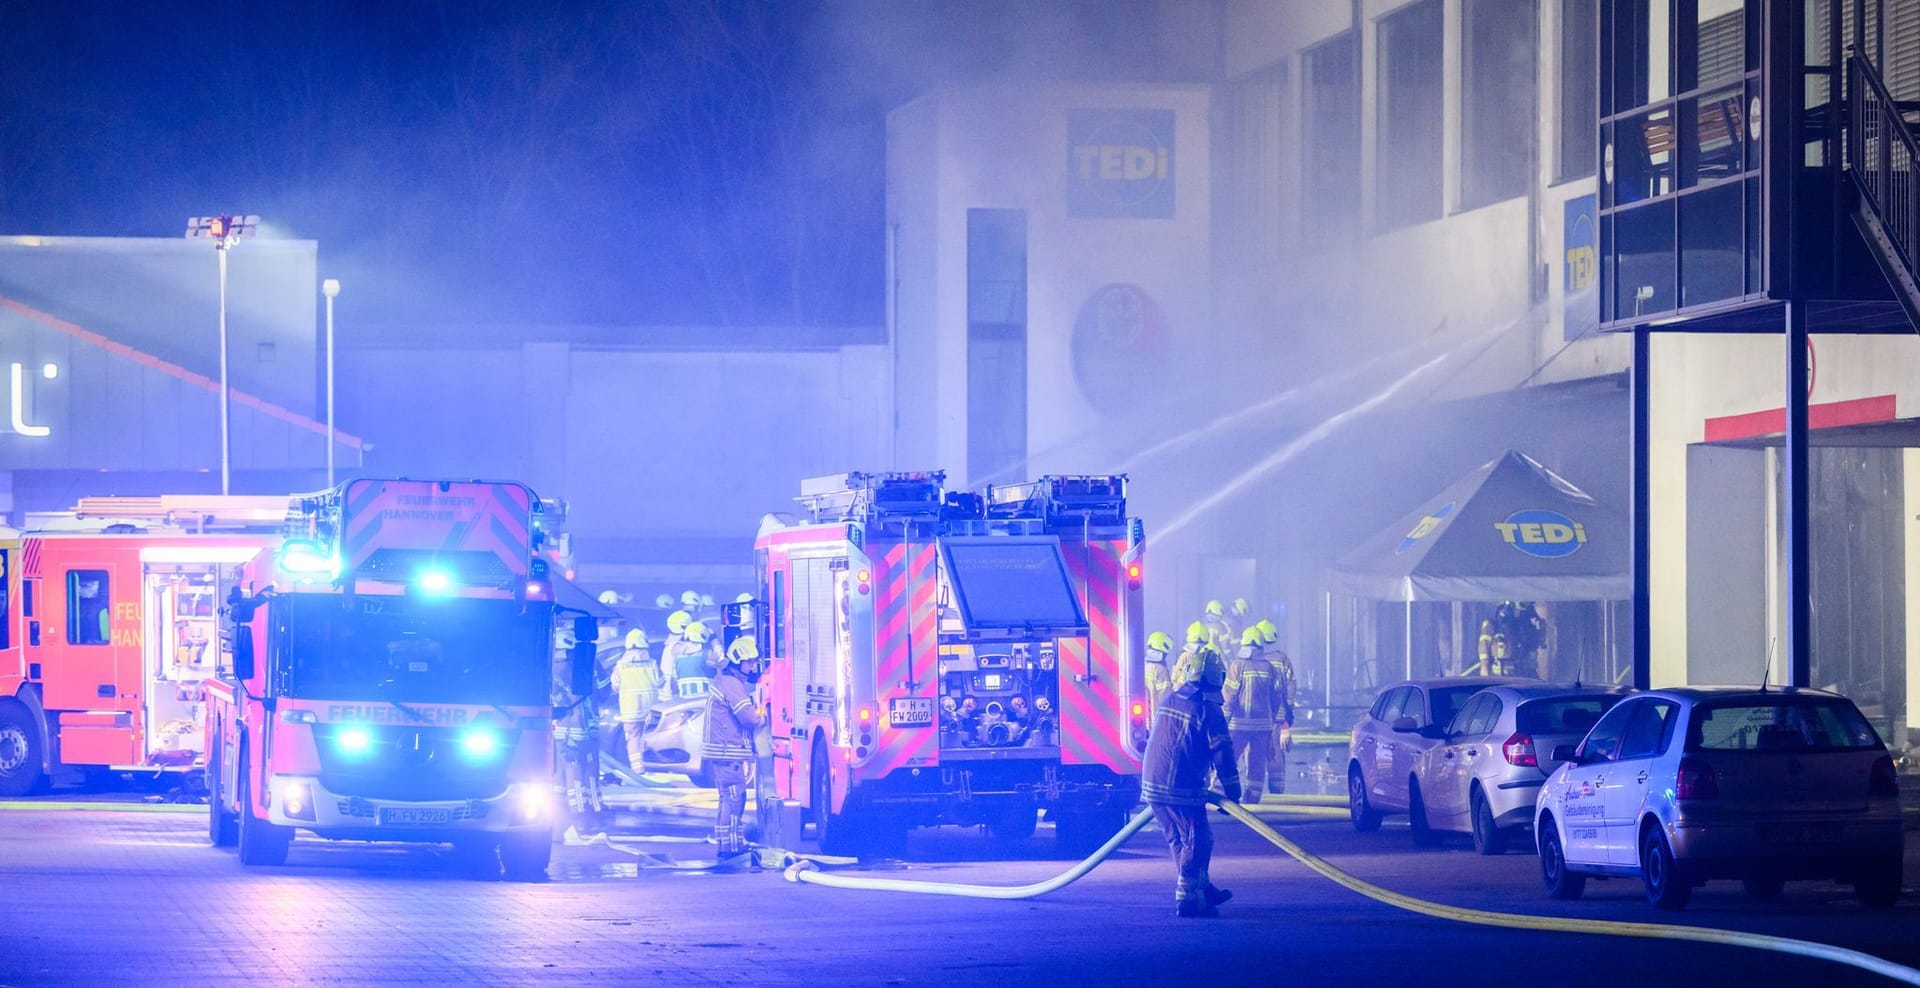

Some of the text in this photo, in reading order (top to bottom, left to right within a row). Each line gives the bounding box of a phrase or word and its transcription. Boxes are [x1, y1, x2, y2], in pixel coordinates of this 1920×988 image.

[1073, 144, 1168, 180] TEDi
[397, 495, 475, 506] FEUERWEHR
[383, 509, 454, 521] HANNOVER
[1493, 522, 1588, 544] TEDi
[910, 701, 916, 710] H
[893, 711, 929, 721] FW 2009
[388, 810, 447, 822] H FW 2926
